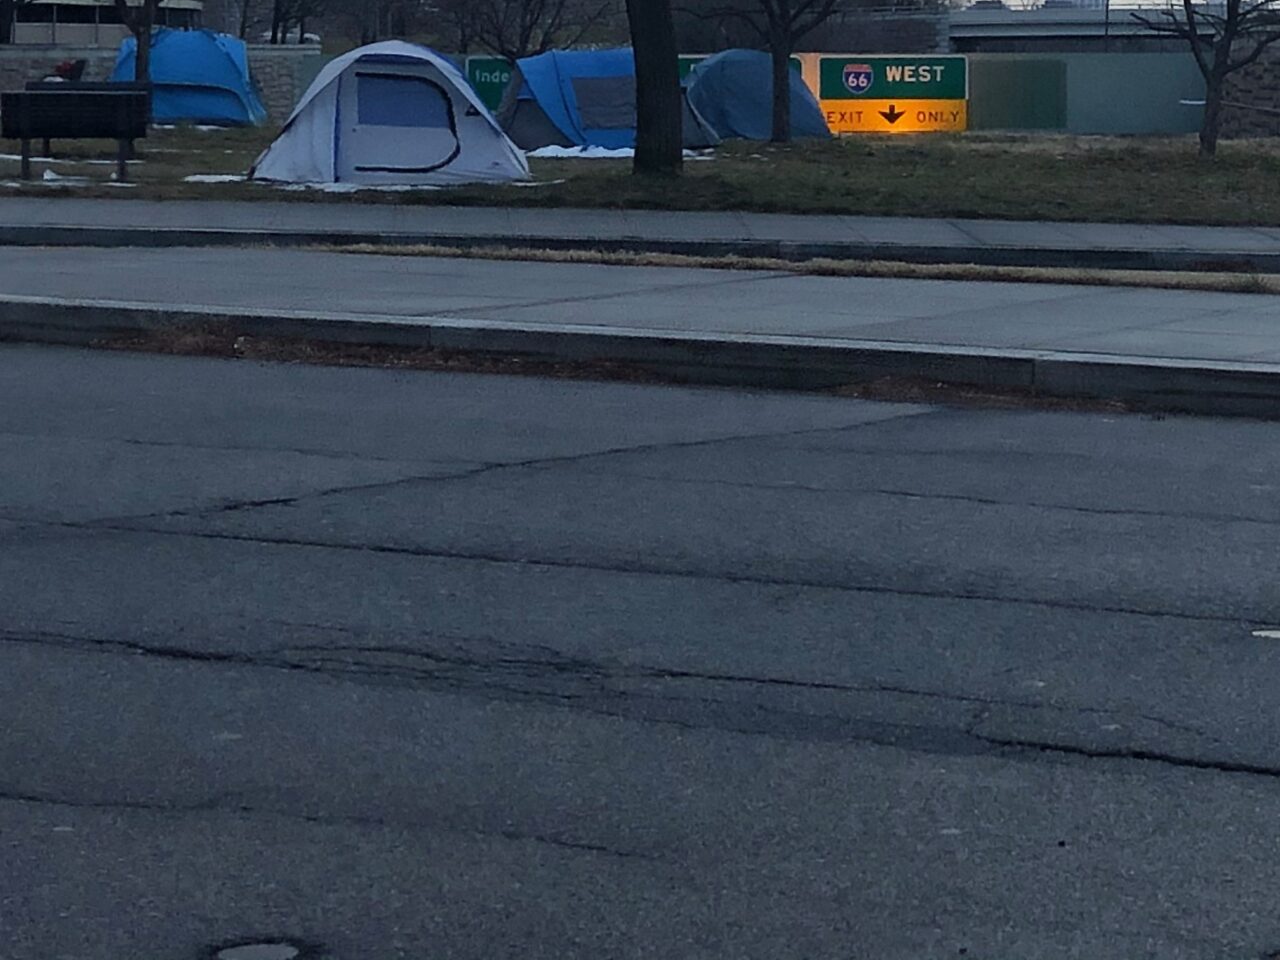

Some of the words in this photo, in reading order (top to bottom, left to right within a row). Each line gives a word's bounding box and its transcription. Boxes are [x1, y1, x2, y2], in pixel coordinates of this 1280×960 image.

[848, 73, 868, 87] 66
[886, 65, 944, 82] WEST
[826, 111, 864, 124] EXIT
[916, 111, 960, 123] ONLY
